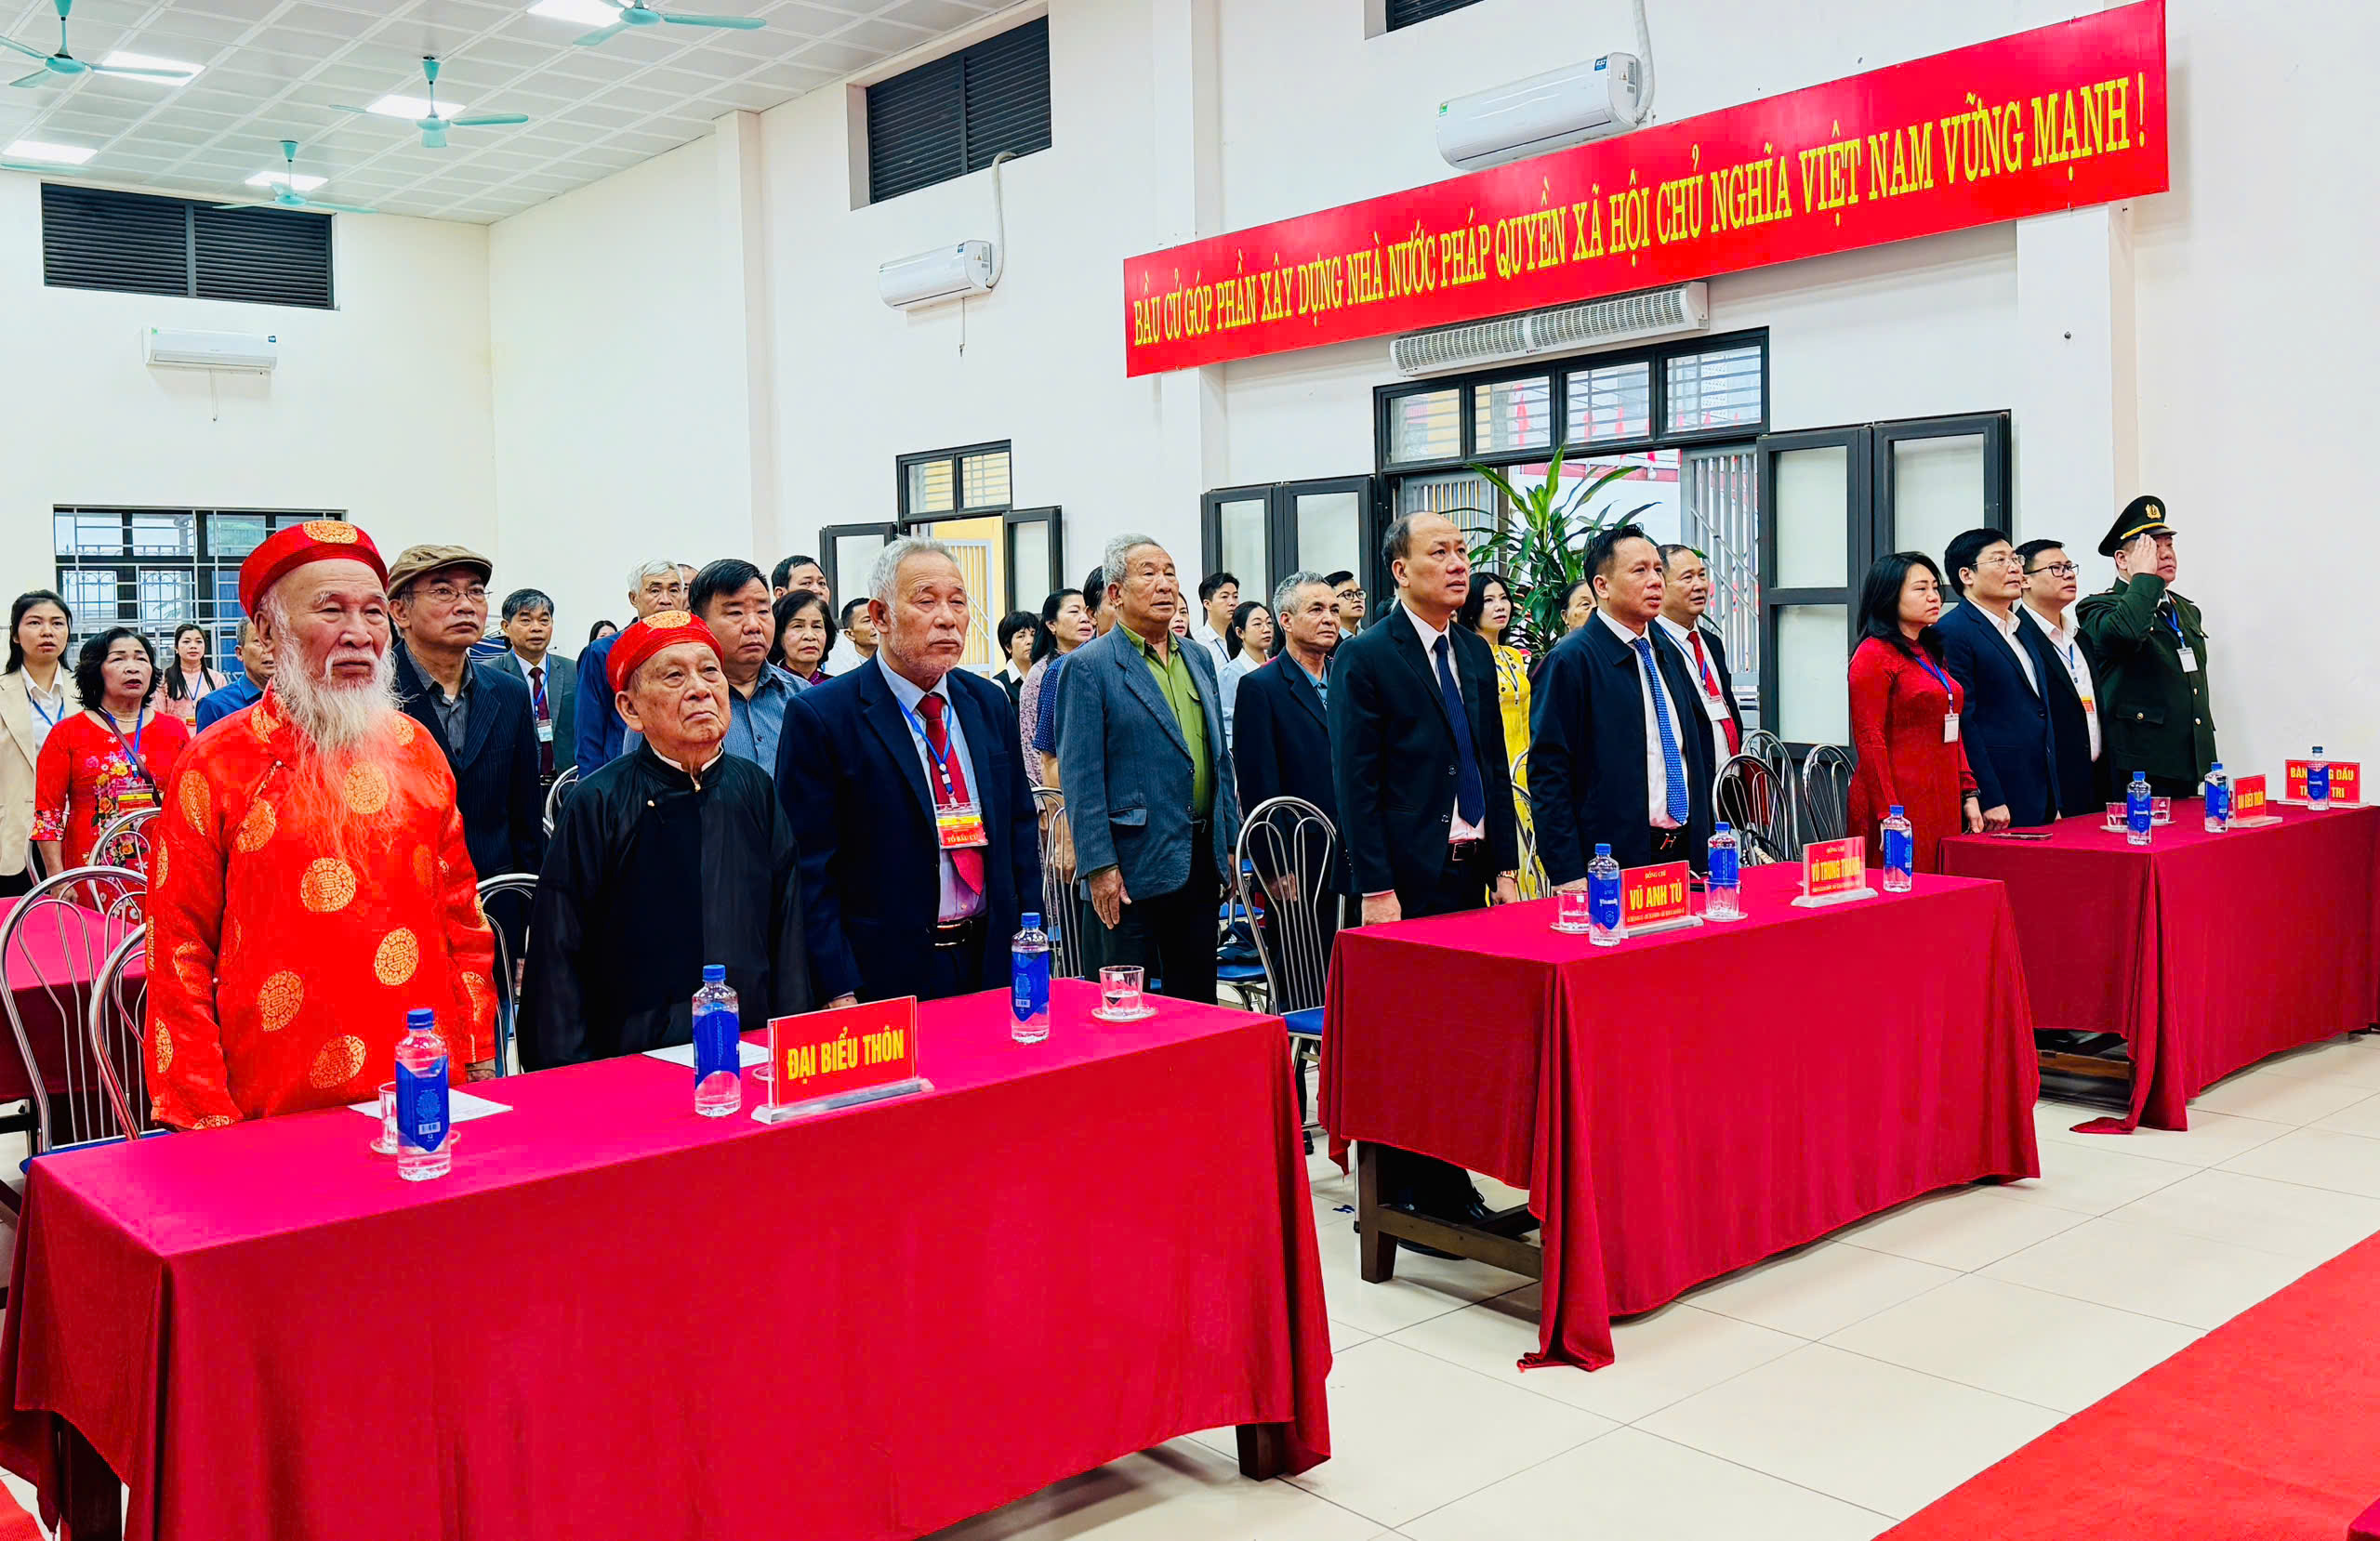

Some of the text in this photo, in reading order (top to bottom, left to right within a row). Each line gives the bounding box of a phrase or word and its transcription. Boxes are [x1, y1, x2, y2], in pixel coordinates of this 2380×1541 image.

[1133, 270, 1161, 346] BẦU
[1164, 268, 1183, 340] CỬ
[1184, 270, 1212, 336] GÓP
[1215, 248, 1257, 330] PHẦN
[1260, 253, 1293, 322] XÂY
[1298, 253, 1342, 327] DỰNG
[1346, 230, 1383, 306] NHÀ
[1388, 219, 1435, 298] NƯỚC
[1440, 208, 1490, 288] PHÁP
[1495, 176, 1567, 280] QUYỀN
[1572, 183, 1604, 261] XÃ
[1609, 168, 1649, 268] HỘI
[1656, 143, 1704, 244] CHỦ
[1710, 142, 1792, 233] NGHĨA
[1799, 119, 1861, 227] VIỆT
[1868, 122, 1934, 201] NAM
[1940, 91, 2024, 184] VỮNG
[2336, 767, 2354, 781] DẤU
[2333, 786, 2345, 798] TRI
[1646, 885, 1668, 908] ANH
[787, 1025, 905, 1085] ĐẠI BIỂU THÔN
